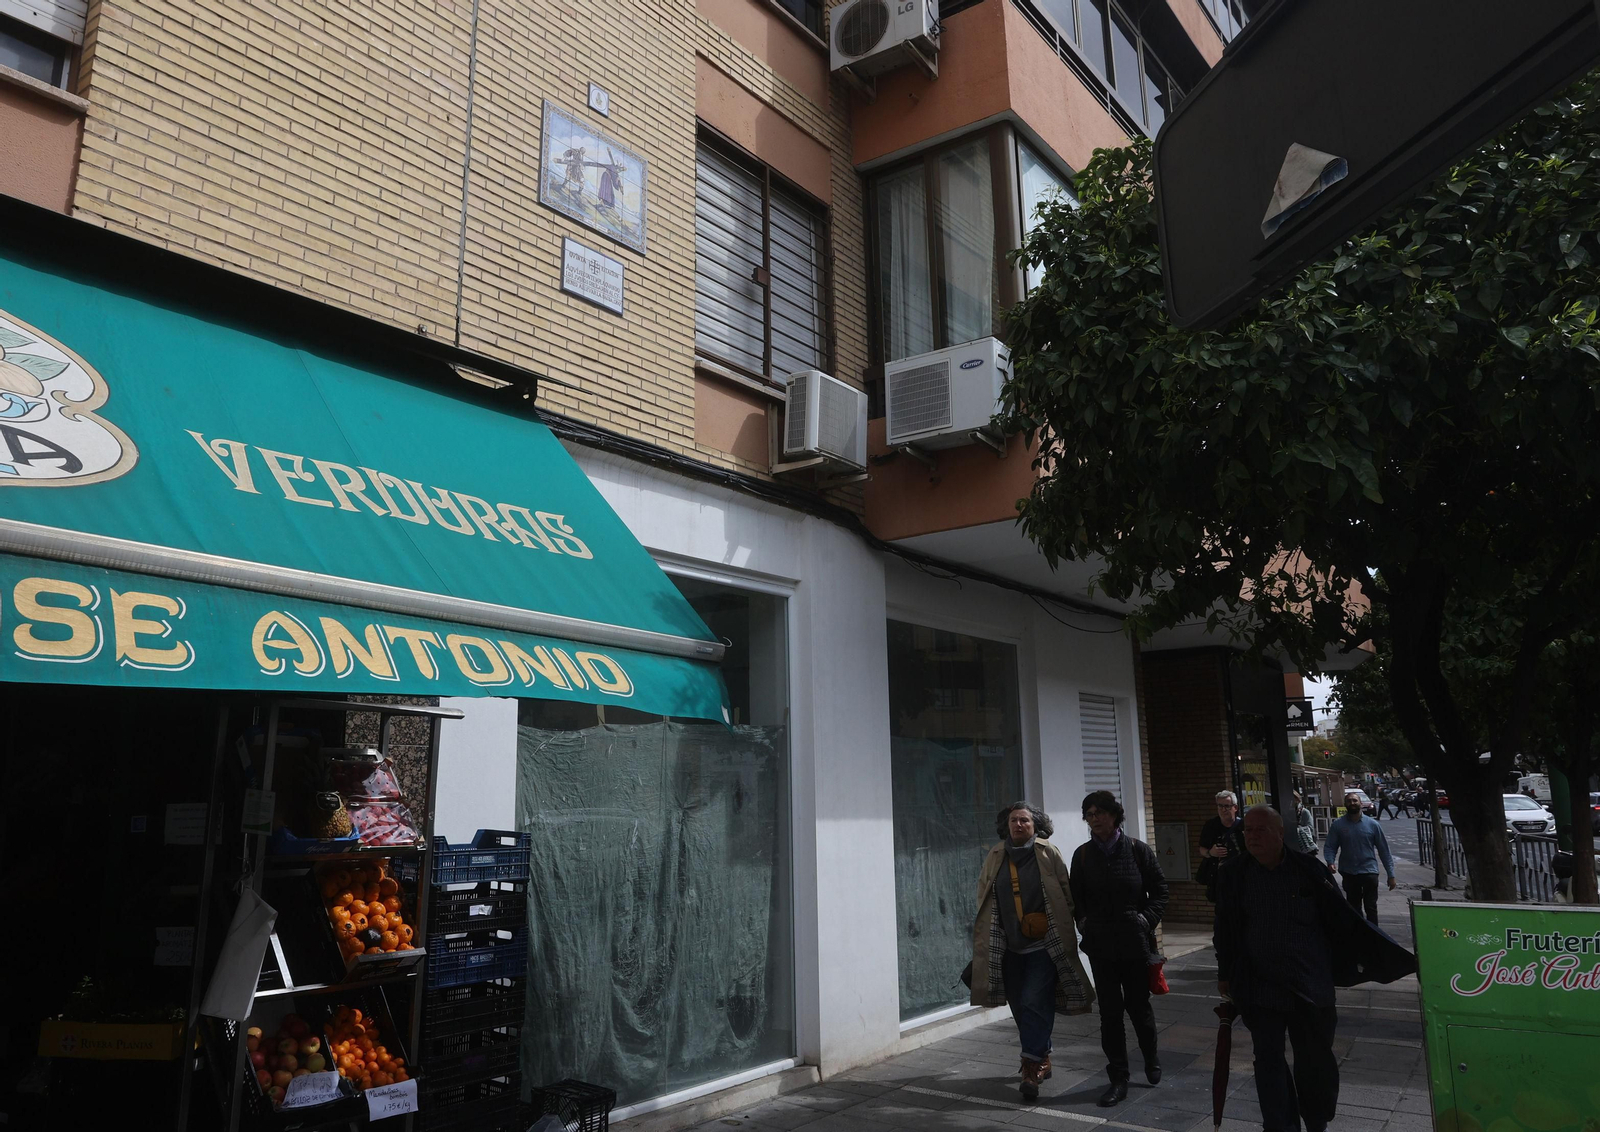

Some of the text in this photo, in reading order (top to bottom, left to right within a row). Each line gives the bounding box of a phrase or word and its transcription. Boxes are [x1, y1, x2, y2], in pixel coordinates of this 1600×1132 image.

[897, 2, 914, 16] LG
[962, 359, 983, 370] Carrier
[185, 428, 594, 560] VERDURAS
[0, 577, 635, 698] SE ANTONIO
[1451, 949, 1537, 996] José
